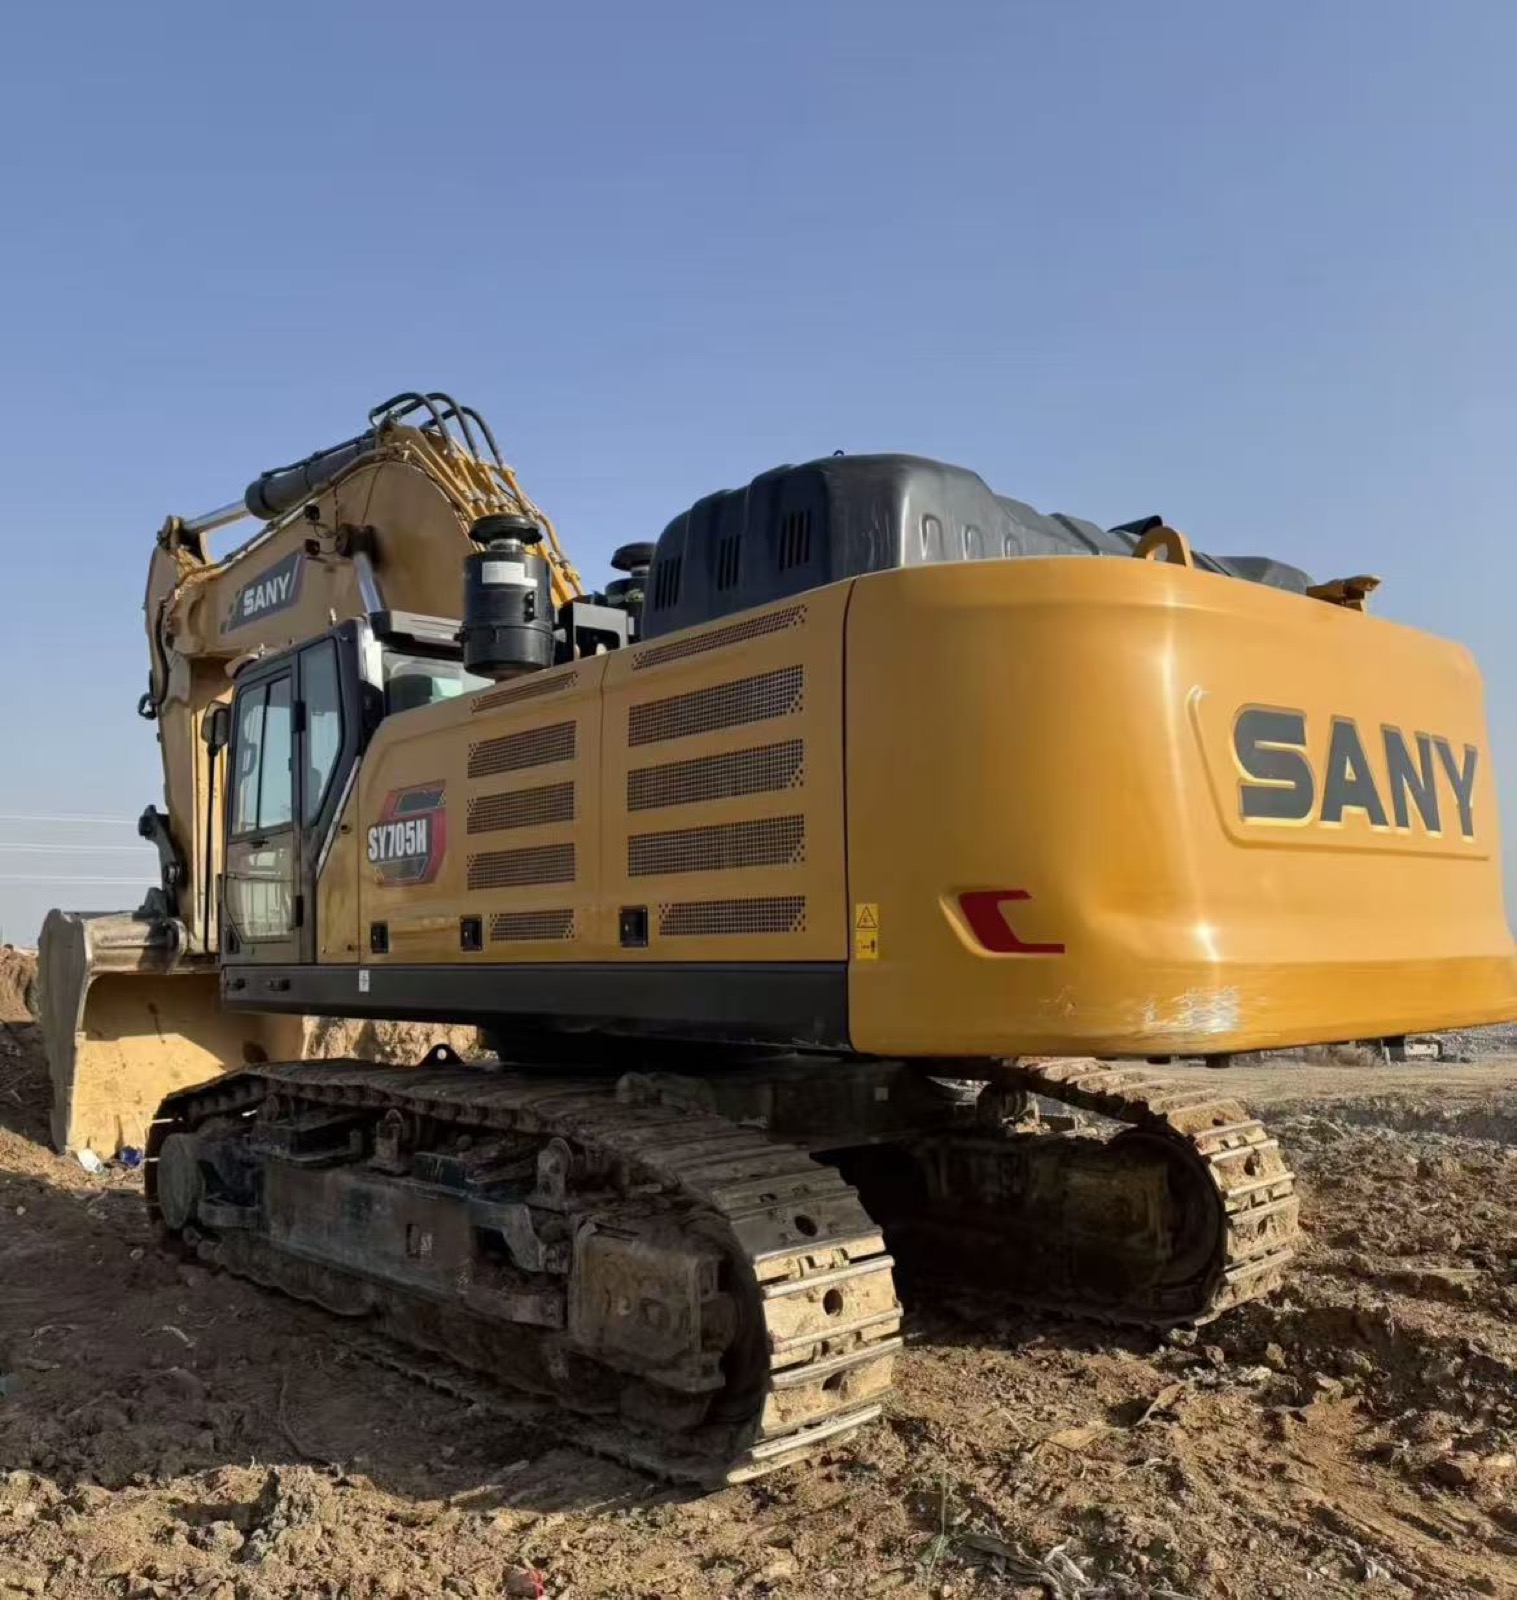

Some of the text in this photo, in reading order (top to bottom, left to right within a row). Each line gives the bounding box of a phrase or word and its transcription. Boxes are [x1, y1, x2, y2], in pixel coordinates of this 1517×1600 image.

[243, 572, 290, 617] SANY
[1233, 704, 1478, 840] SANY
[367, 818, 427, 861] SY705H
